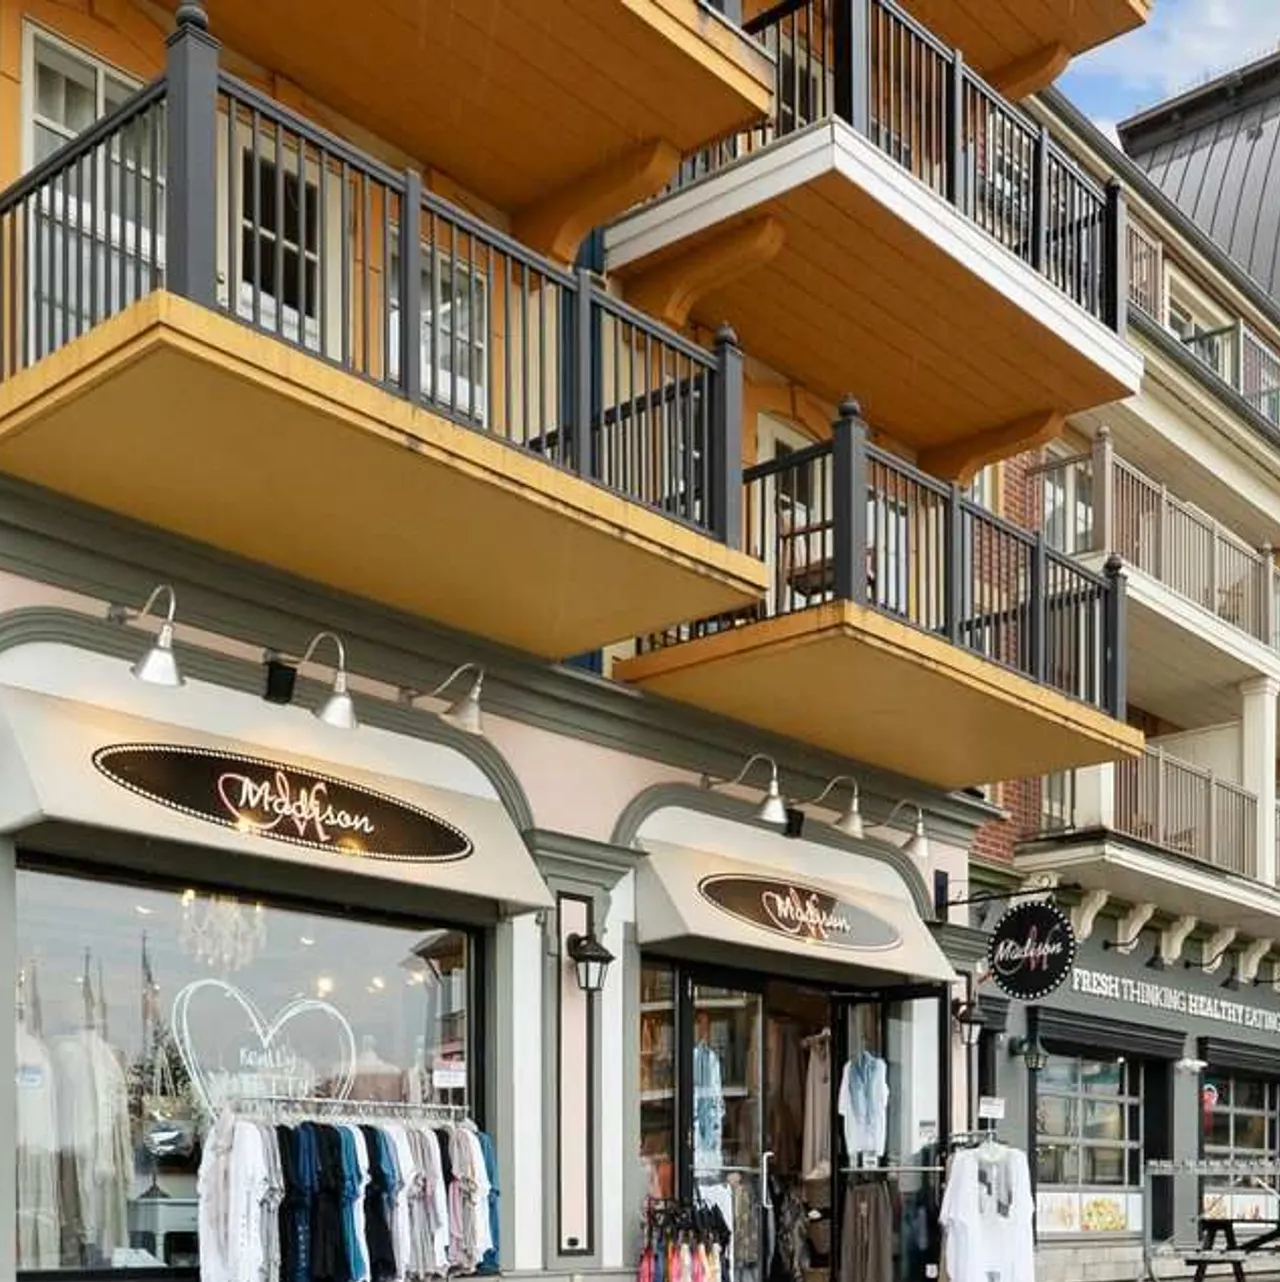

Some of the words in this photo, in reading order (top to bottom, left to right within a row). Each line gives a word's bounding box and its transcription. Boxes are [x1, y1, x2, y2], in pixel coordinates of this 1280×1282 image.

[1072, 968, 1120, 999] FRESH
[1122, 977, 1186, 1012] THINKING
[1188, 992, 1244, 1024] HEALTHY
